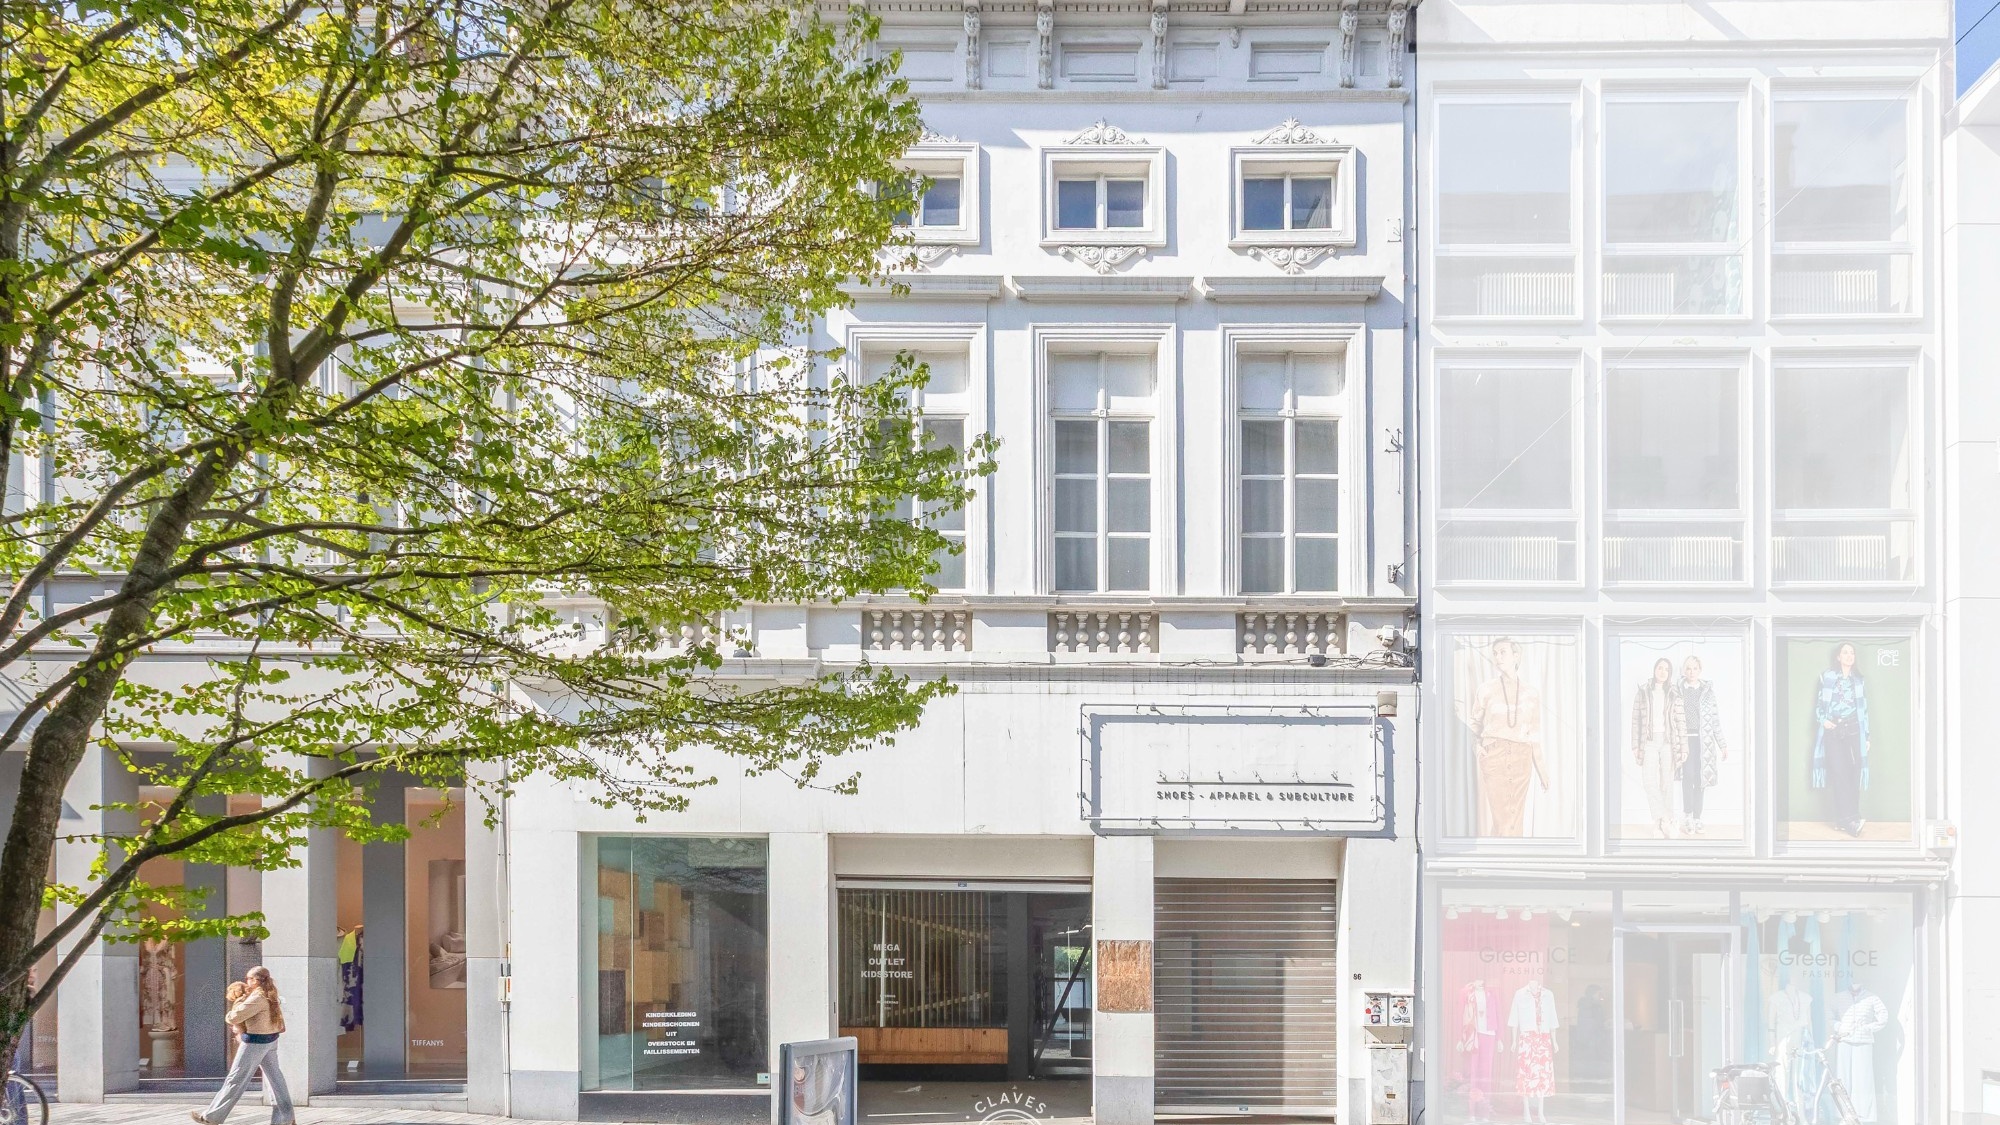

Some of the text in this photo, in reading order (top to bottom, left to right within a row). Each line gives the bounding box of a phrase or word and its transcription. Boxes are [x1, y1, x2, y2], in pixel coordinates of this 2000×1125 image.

[1877, 654, 1900, 666] ICE
[1156, 791, 1195, 801] SHOES
[1209, 791, 1262, 802] APPAREL
[1279, 792, 1355, 802] SUBCULTURE
[873, 943, 900, 951] MEGA
[1479, 946, 1577, 964] Green ICE
[1778, 949, 1878, 967] Green ICE
[868, 957, 905, 966] OUTLET
[860, 970, 913, 979] KIDSSTORE
[1802, 970, 1853, 978] FASHION
[411, 1039, 444, 1047] TIFFANYS
